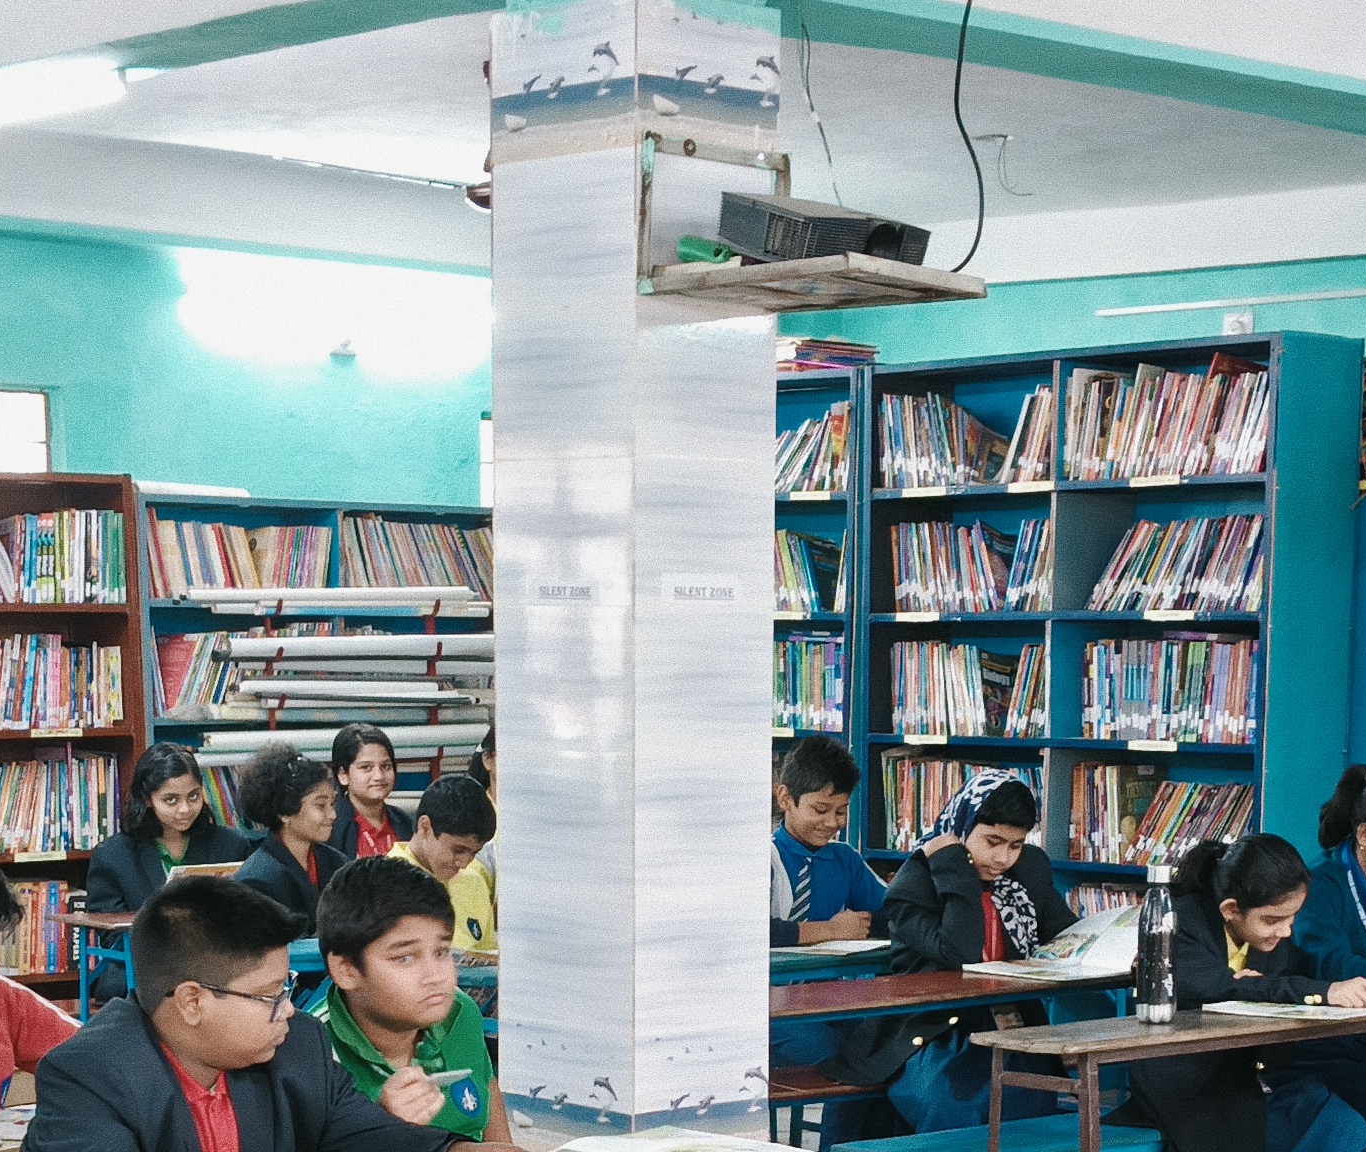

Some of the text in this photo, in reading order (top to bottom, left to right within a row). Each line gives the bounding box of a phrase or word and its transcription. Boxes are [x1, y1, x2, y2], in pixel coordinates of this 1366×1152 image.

[538, 586, 567, 597] SILENT
[674, 587, 734, 598] SILENT ZONE
